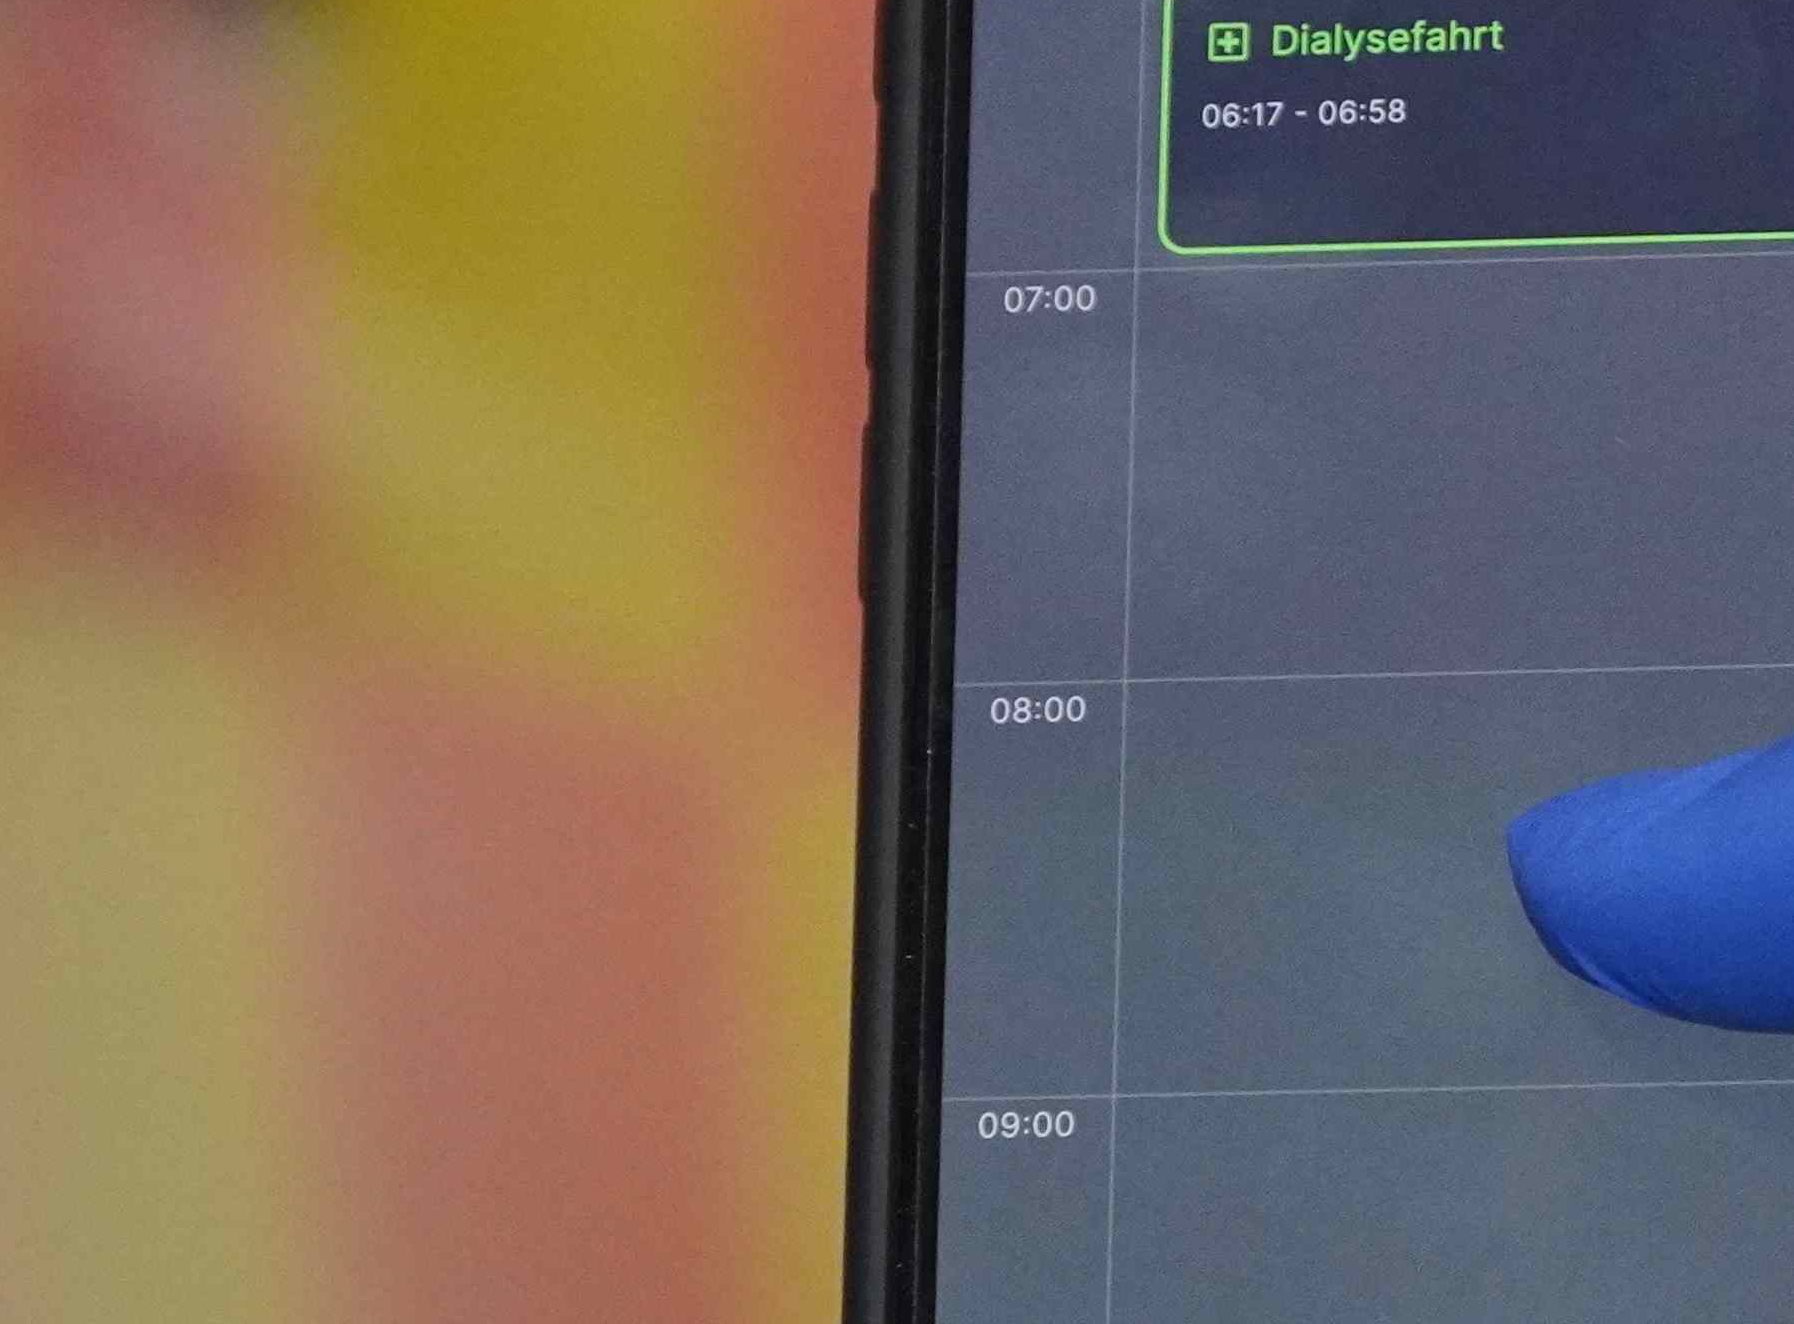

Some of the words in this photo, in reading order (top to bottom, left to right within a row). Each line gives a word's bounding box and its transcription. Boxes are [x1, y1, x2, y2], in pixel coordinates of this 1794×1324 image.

[1272, 19, 1503, 62] Dialysefahrt
[1202, 101, 1284, 129] 06:17
[1318, 98, 1407, 126] 06:58
[1003, 284, 1097, 314] 07:00
[990, 695, 1087, 725] 08:00
[978, 1110, 1076, 1140] 09:00
